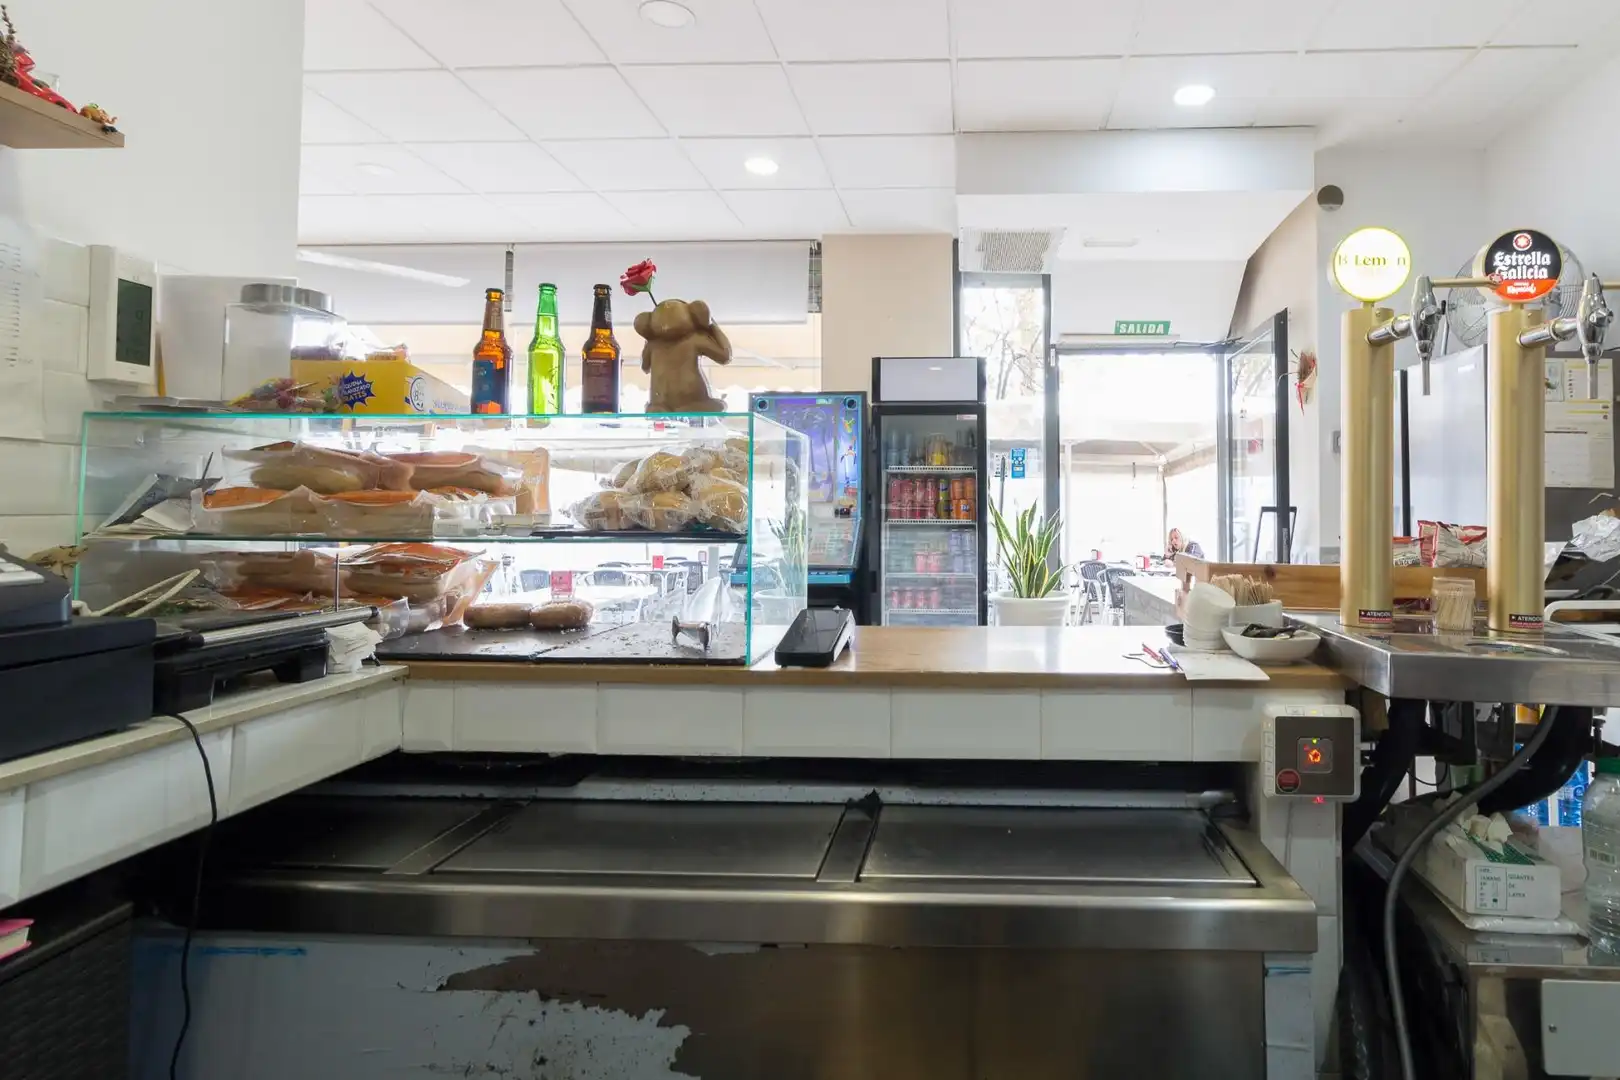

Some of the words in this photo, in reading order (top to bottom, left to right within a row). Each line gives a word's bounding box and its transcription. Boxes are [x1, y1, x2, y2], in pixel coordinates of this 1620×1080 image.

[1354, 254, 1406, 266] Lemn
[1493, 251, 1551, 266] Estrella
[1495, 265, 1549, 280] Galicia
[1119, 323, 1164, 334] SALIDA
